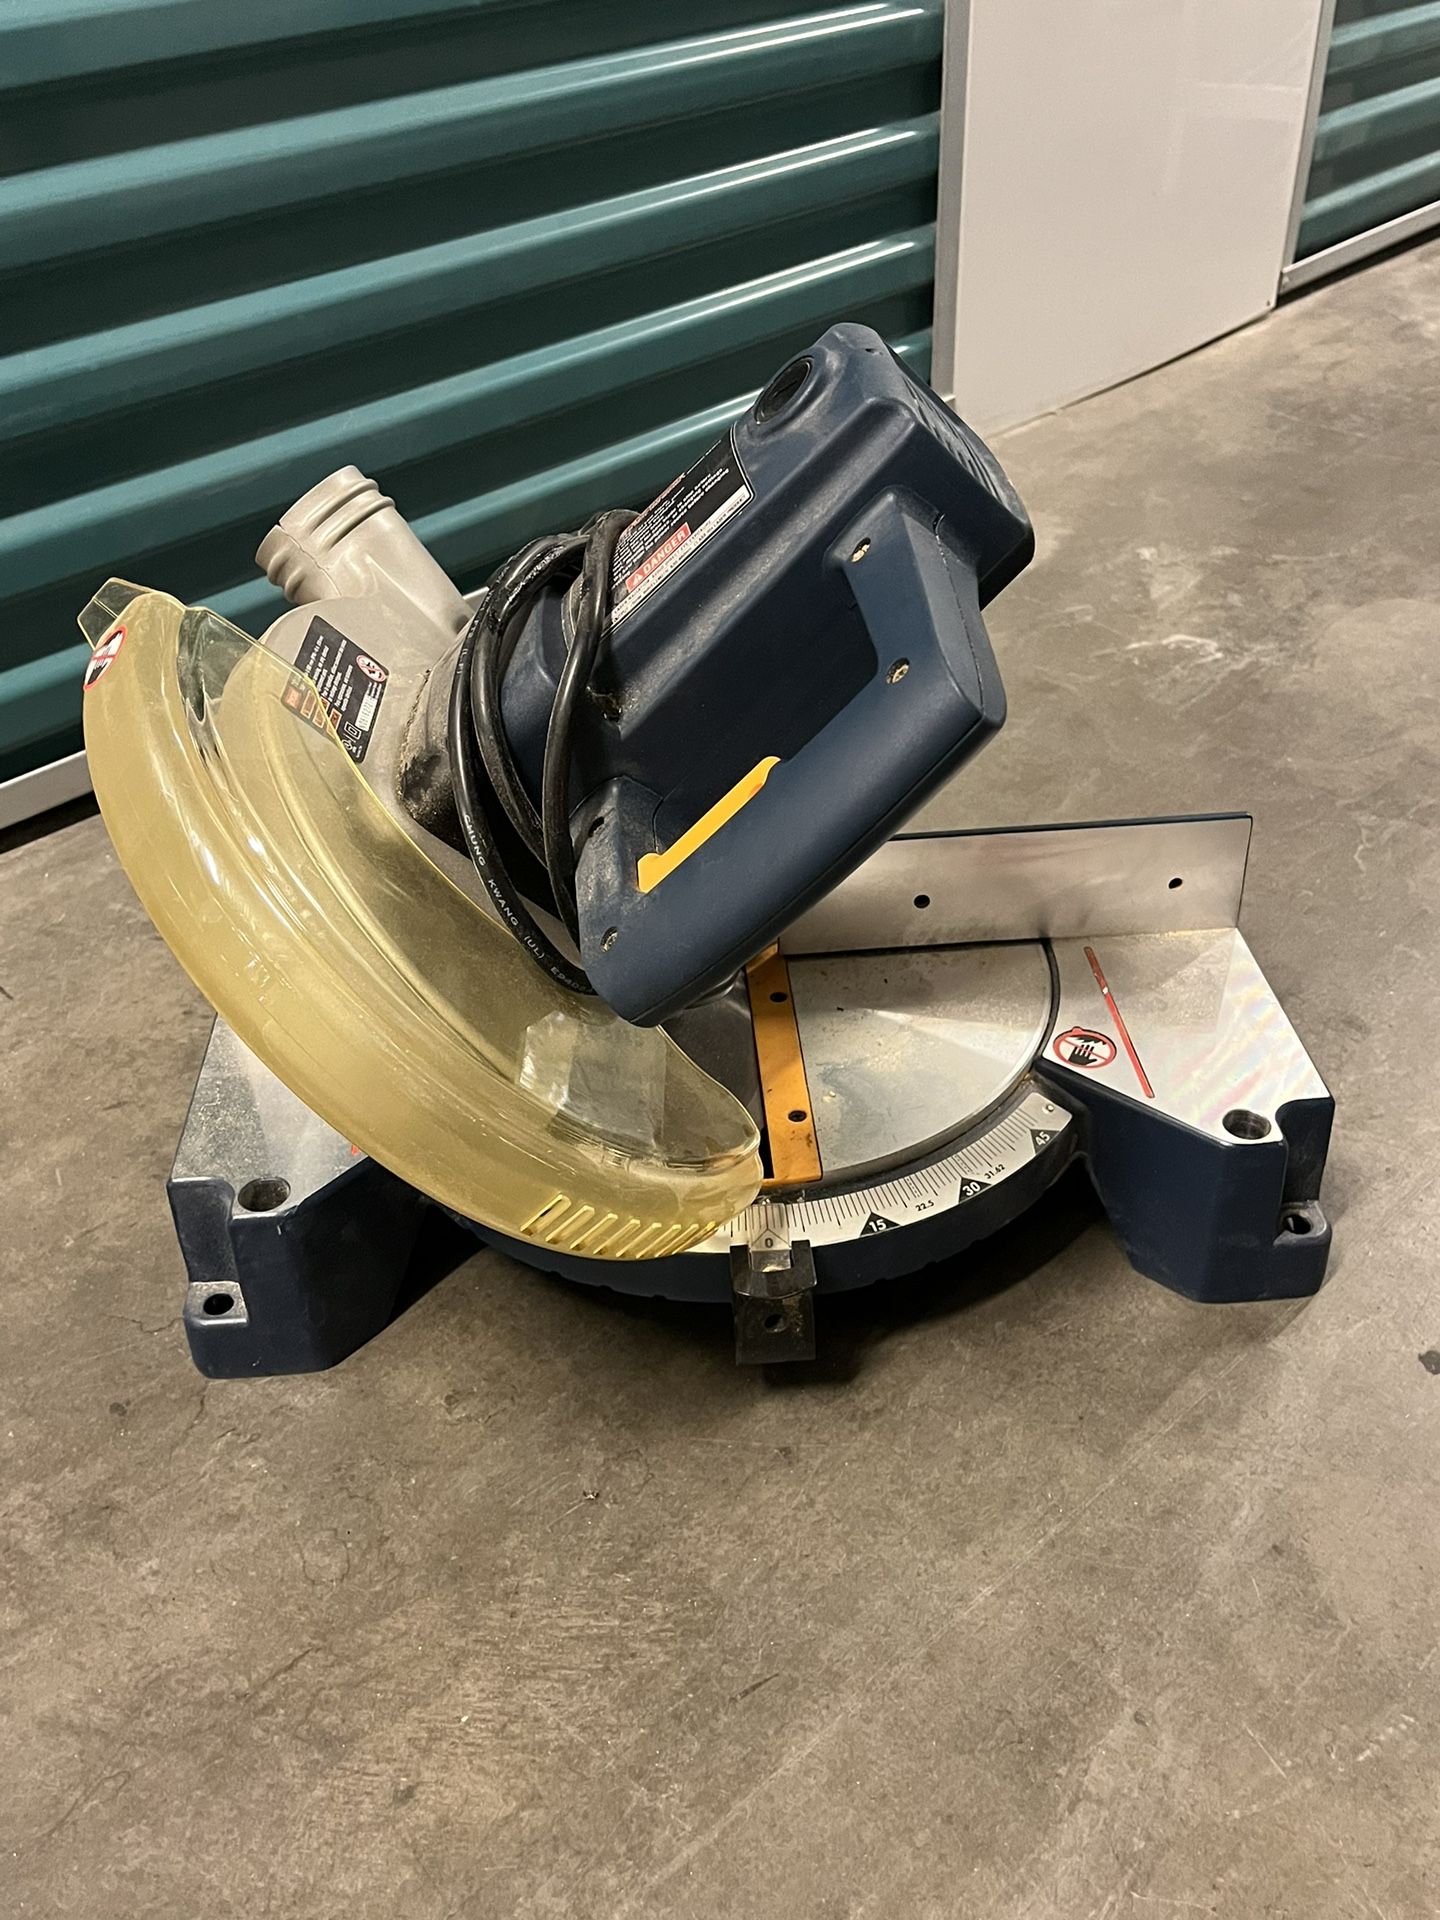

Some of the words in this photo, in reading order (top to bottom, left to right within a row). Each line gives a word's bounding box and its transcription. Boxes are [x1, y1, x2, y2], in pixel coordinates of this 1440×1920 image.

[643, 529, 686, 574] DANGER
[464, 814, 486, 867] CHUNG
[488, 878, 519, 926] KWANG
[524, 935, 545, 959] (UL)
[1035, 1132, 1050, 1146] 45
[983, 1163, 1006, 1180] 31.62
[961, 1181, 980, 1194] 30
[915, 1200, 935, 1212] 22.5
[868, 1218, 888, 1232] 15
[764, 1238, 774, 1248] 0
